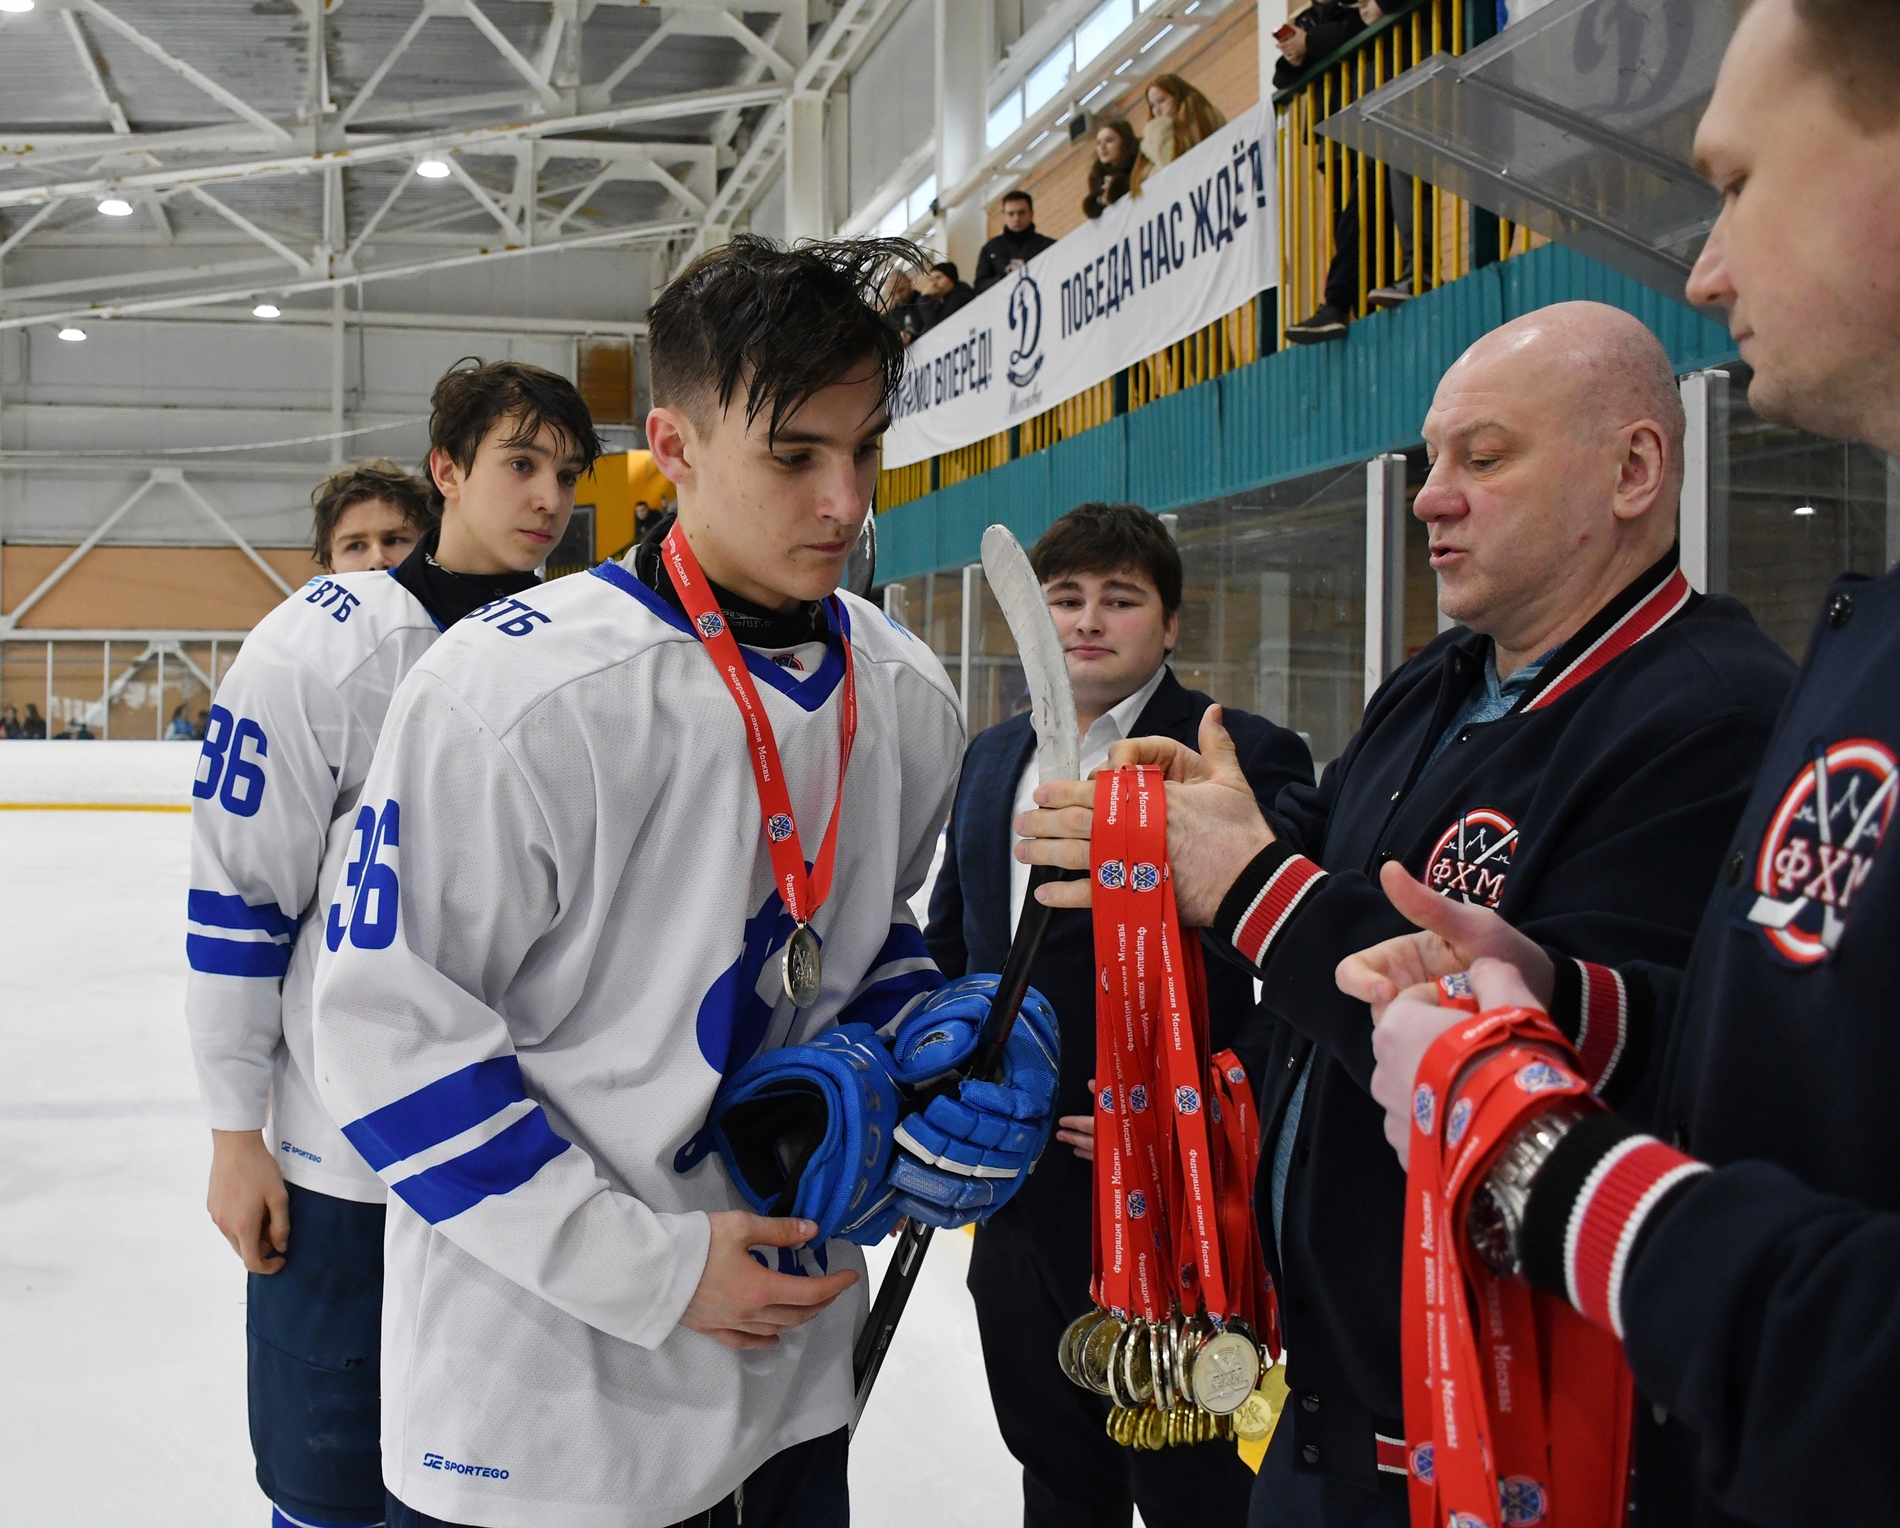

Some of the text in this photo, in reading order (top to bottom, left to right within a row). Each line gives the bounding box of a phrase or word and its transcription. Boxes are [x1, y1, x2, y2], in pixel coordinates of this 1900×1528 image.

[1060, 236, 1134, 340] ПОБЕДА
[1139, 200, 1185, 289] НАС
[935, 327, 992, 405] ВПЕРЁД!
[671, 553, 690, 587] Москвы
[305, 580, 361, 622] ВТБ
[463, 597, 552, 636] ВТБ
[727, 664, 771, 783] Федерация хоккея Москвы
[1107, 776, 1119, 825] Федерация
[1139, 791, 1149, 827] Москвы
[326, 798, 400, 952] 36
[1432, 858, 1506, 900] ФХМ
[1135, 926, 1147, 978] Федерация
[1125, 1000, 1134, 1052] Федерация
[1168, 976, 1176, 1009] хоккея
[1172, 1012, 1181, 1051] Москвы
[1119, 1083, 1127, 1115] хоккея
[292, 1147, 322, 1163] SPORTEGO
[1122, 1118, 1132, 1157] Москвы
[1188, 1149, 1211, 1278] Федерация хоккея Москвы
[1421, 1190, 1433, 1251] Москвы
[1113, 1223, 1123, 1274] Федерация
[1138, 1252, 1150, 1304] Федерация
[1441, 1378, 1458, 1449] Москвы
[444, 1460, 510, 1480] SPORTEGO
